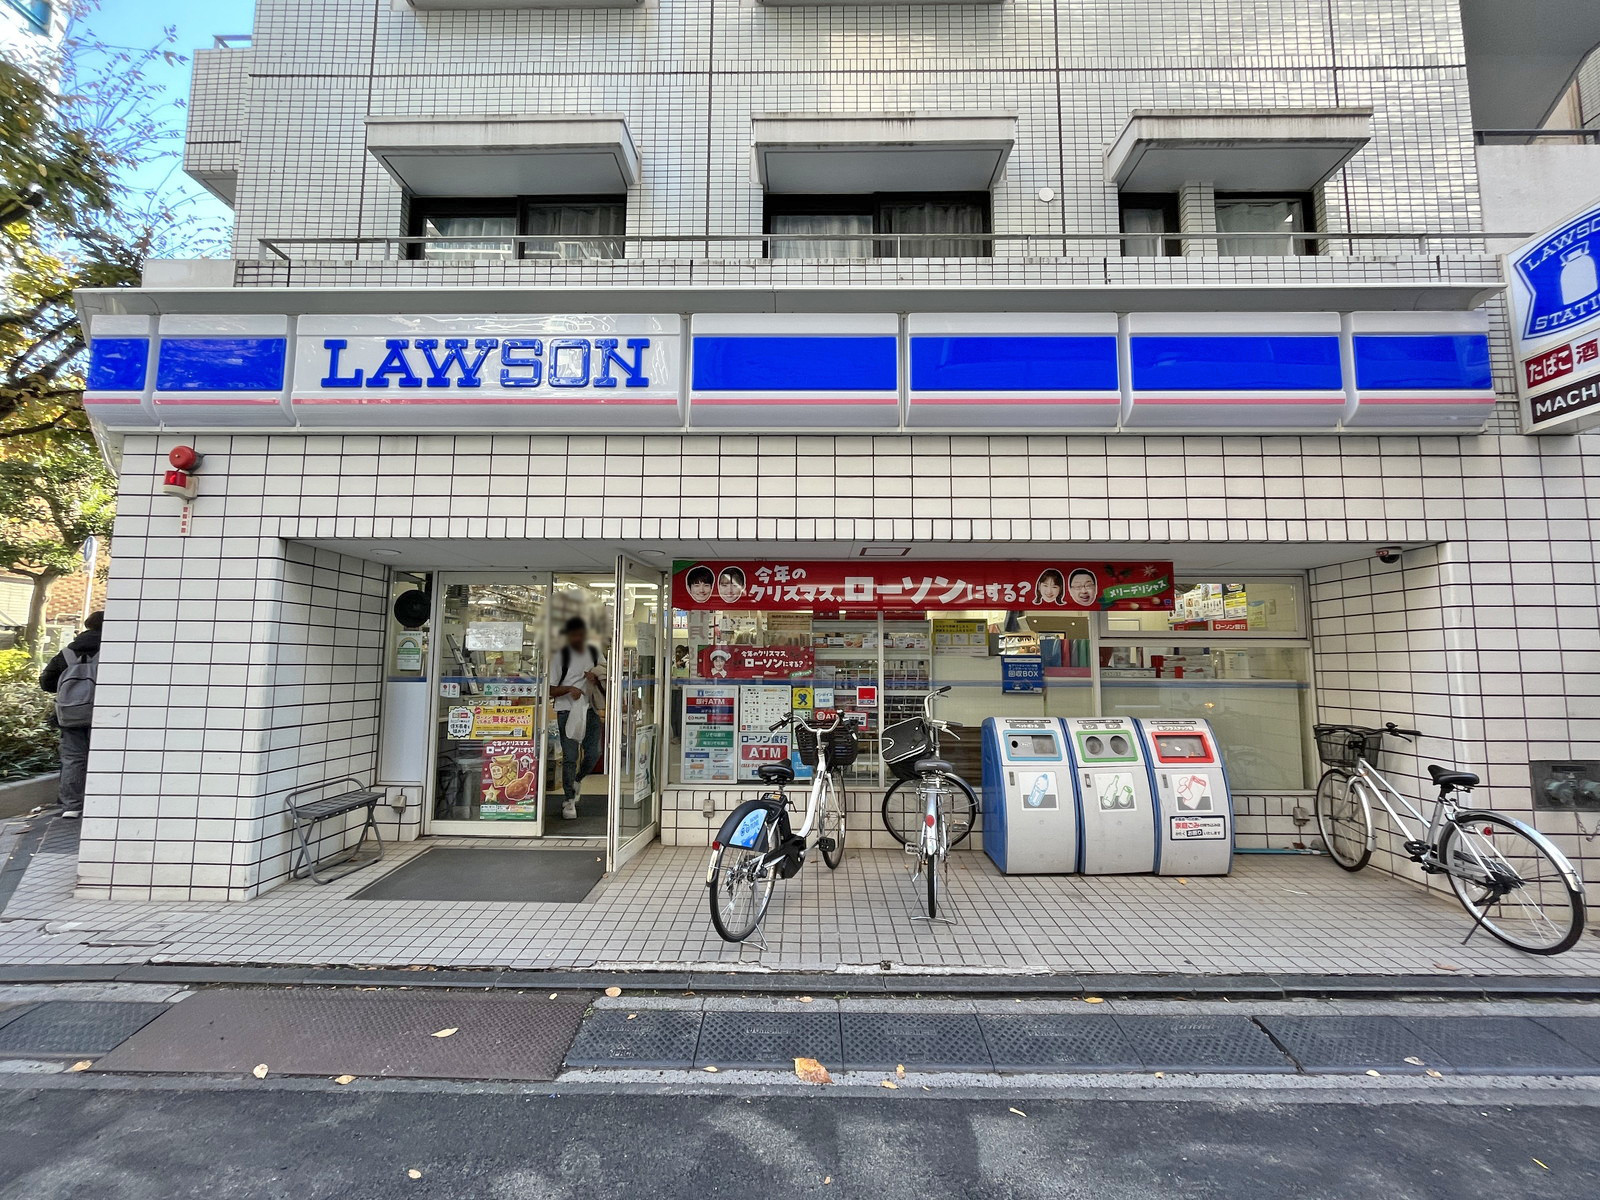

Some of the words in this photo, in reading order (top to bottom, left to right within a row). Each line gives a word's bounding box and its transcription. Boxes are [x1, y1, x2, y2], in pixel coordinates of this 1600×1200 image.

[1535, 293, 1600, 331] STATI
[320, 338, 651, 388] LAWSON
[1528, 350, 1572, 383] たばこ
[1576, 338, 1599, 364] 酒
[754, 564, 807, 584] 今年の
[1109, 581, 1167, 598] メリーデリシャス
[744, 658, 804, 668] ローソンにする？
[1008, 670, 1039, 678] 回収BOX
[741, 735, 788, 744] ローソン銀行
[748, 747, 781, 758] ATM
